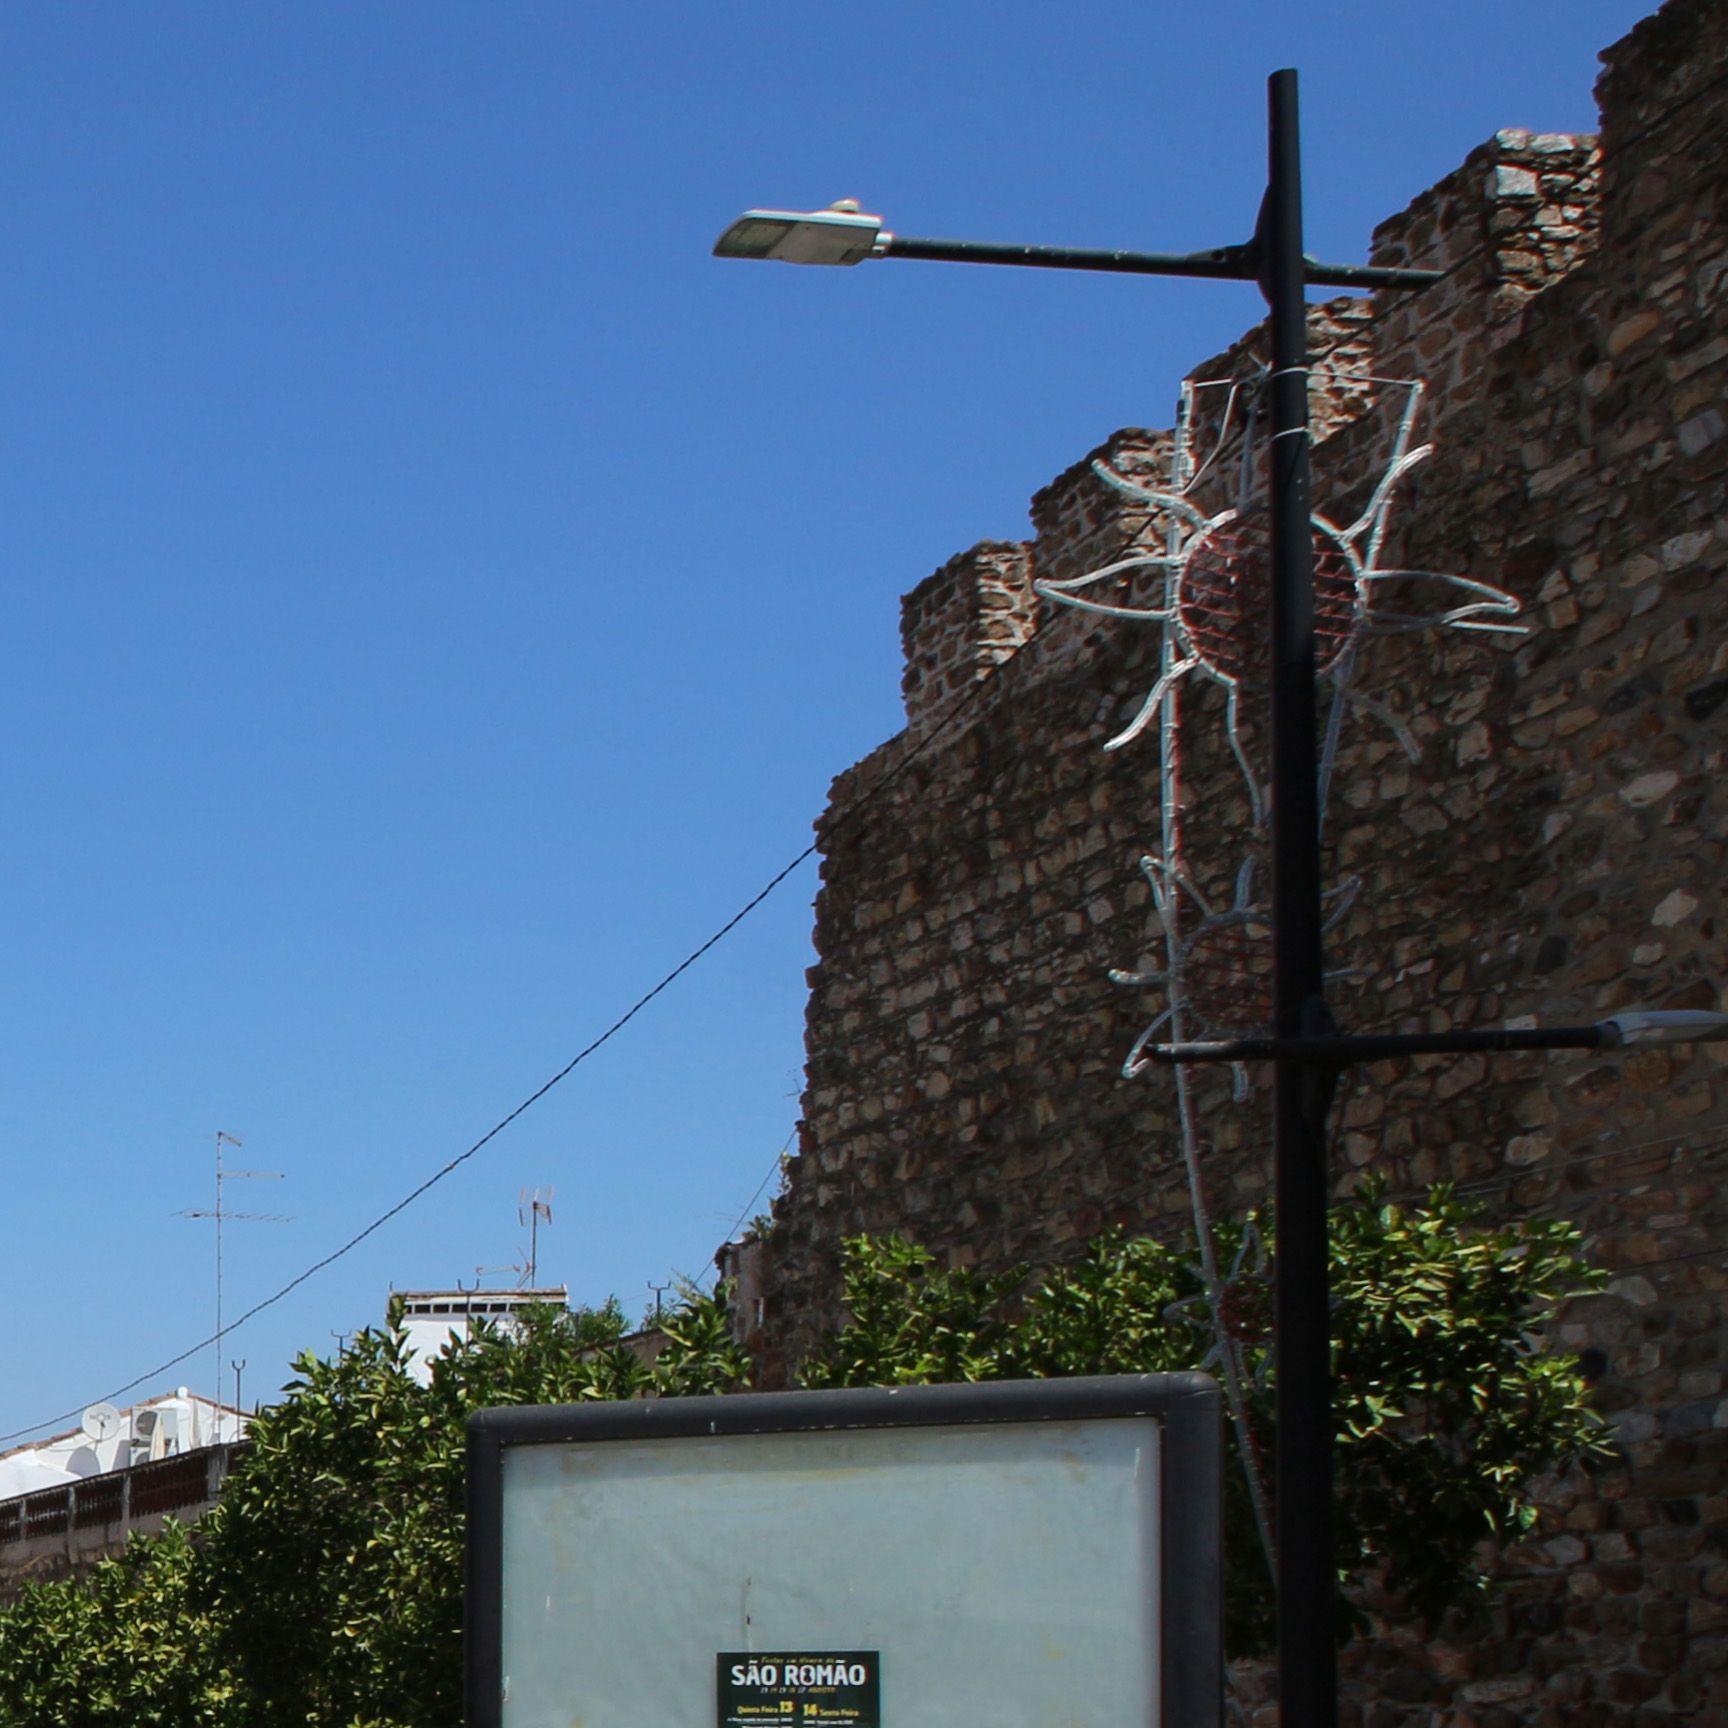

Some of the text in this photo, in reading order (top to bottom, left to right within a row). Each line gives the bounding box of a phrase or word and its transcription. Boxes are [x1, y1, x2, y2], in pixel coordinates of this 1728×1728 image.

[731, 1659, 866, 1686] SÃO ROMÃO
[779, 1701, 794, 1714] 13
